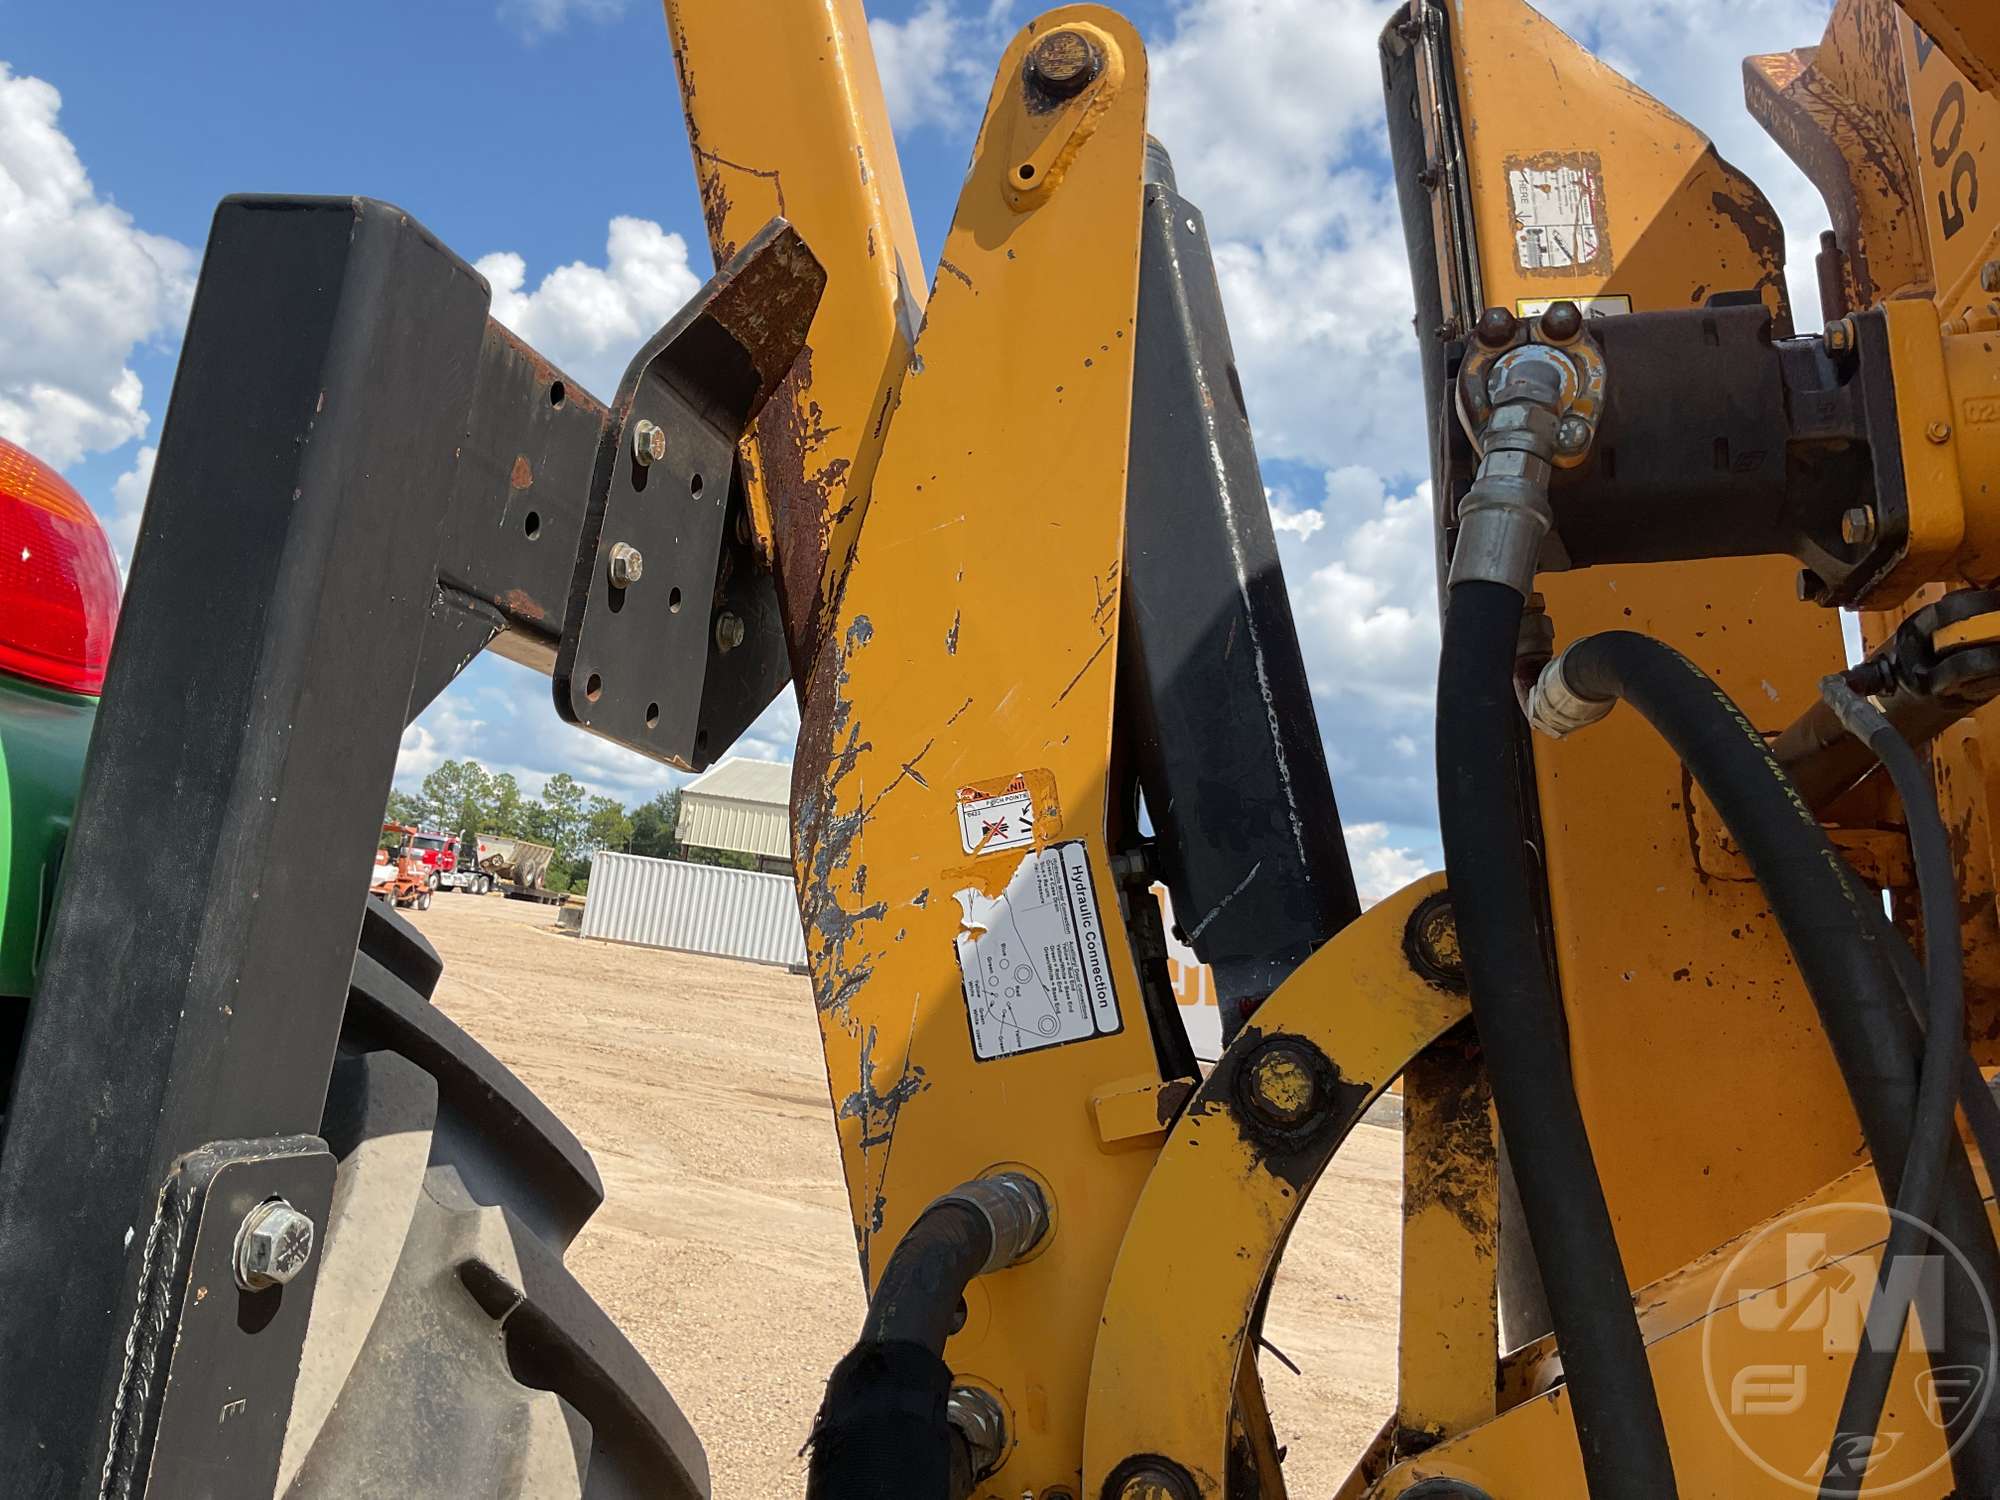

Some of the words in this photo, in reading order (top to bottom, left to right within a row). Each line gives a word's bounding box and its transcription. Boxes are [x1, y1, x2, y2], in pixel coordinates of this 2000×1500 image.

[1518, 180, 1529, 204] HERE
[1036, 879, 1045, 904] Pressure
[1051, 857, 1061, 884] Hydraulic
[1060, 902, 1071, 934] Connection
[1071, 865, 1092, 928] Hydraulic
[1084, 930, 1108, 1008] Connection
[1062, 942, 1070, 960] Yellow
[986, 956, 994, 974] Green
[967, 980, 975, 997] White
[973, 979, 981, 998] Yellow
[1077, 983, 1088, 1019] Connections
[972, 1008, 980, 1025] White
[978, 1007, 986, 1025] Green
[1014, 1029, 1022, 1048] Yellow
